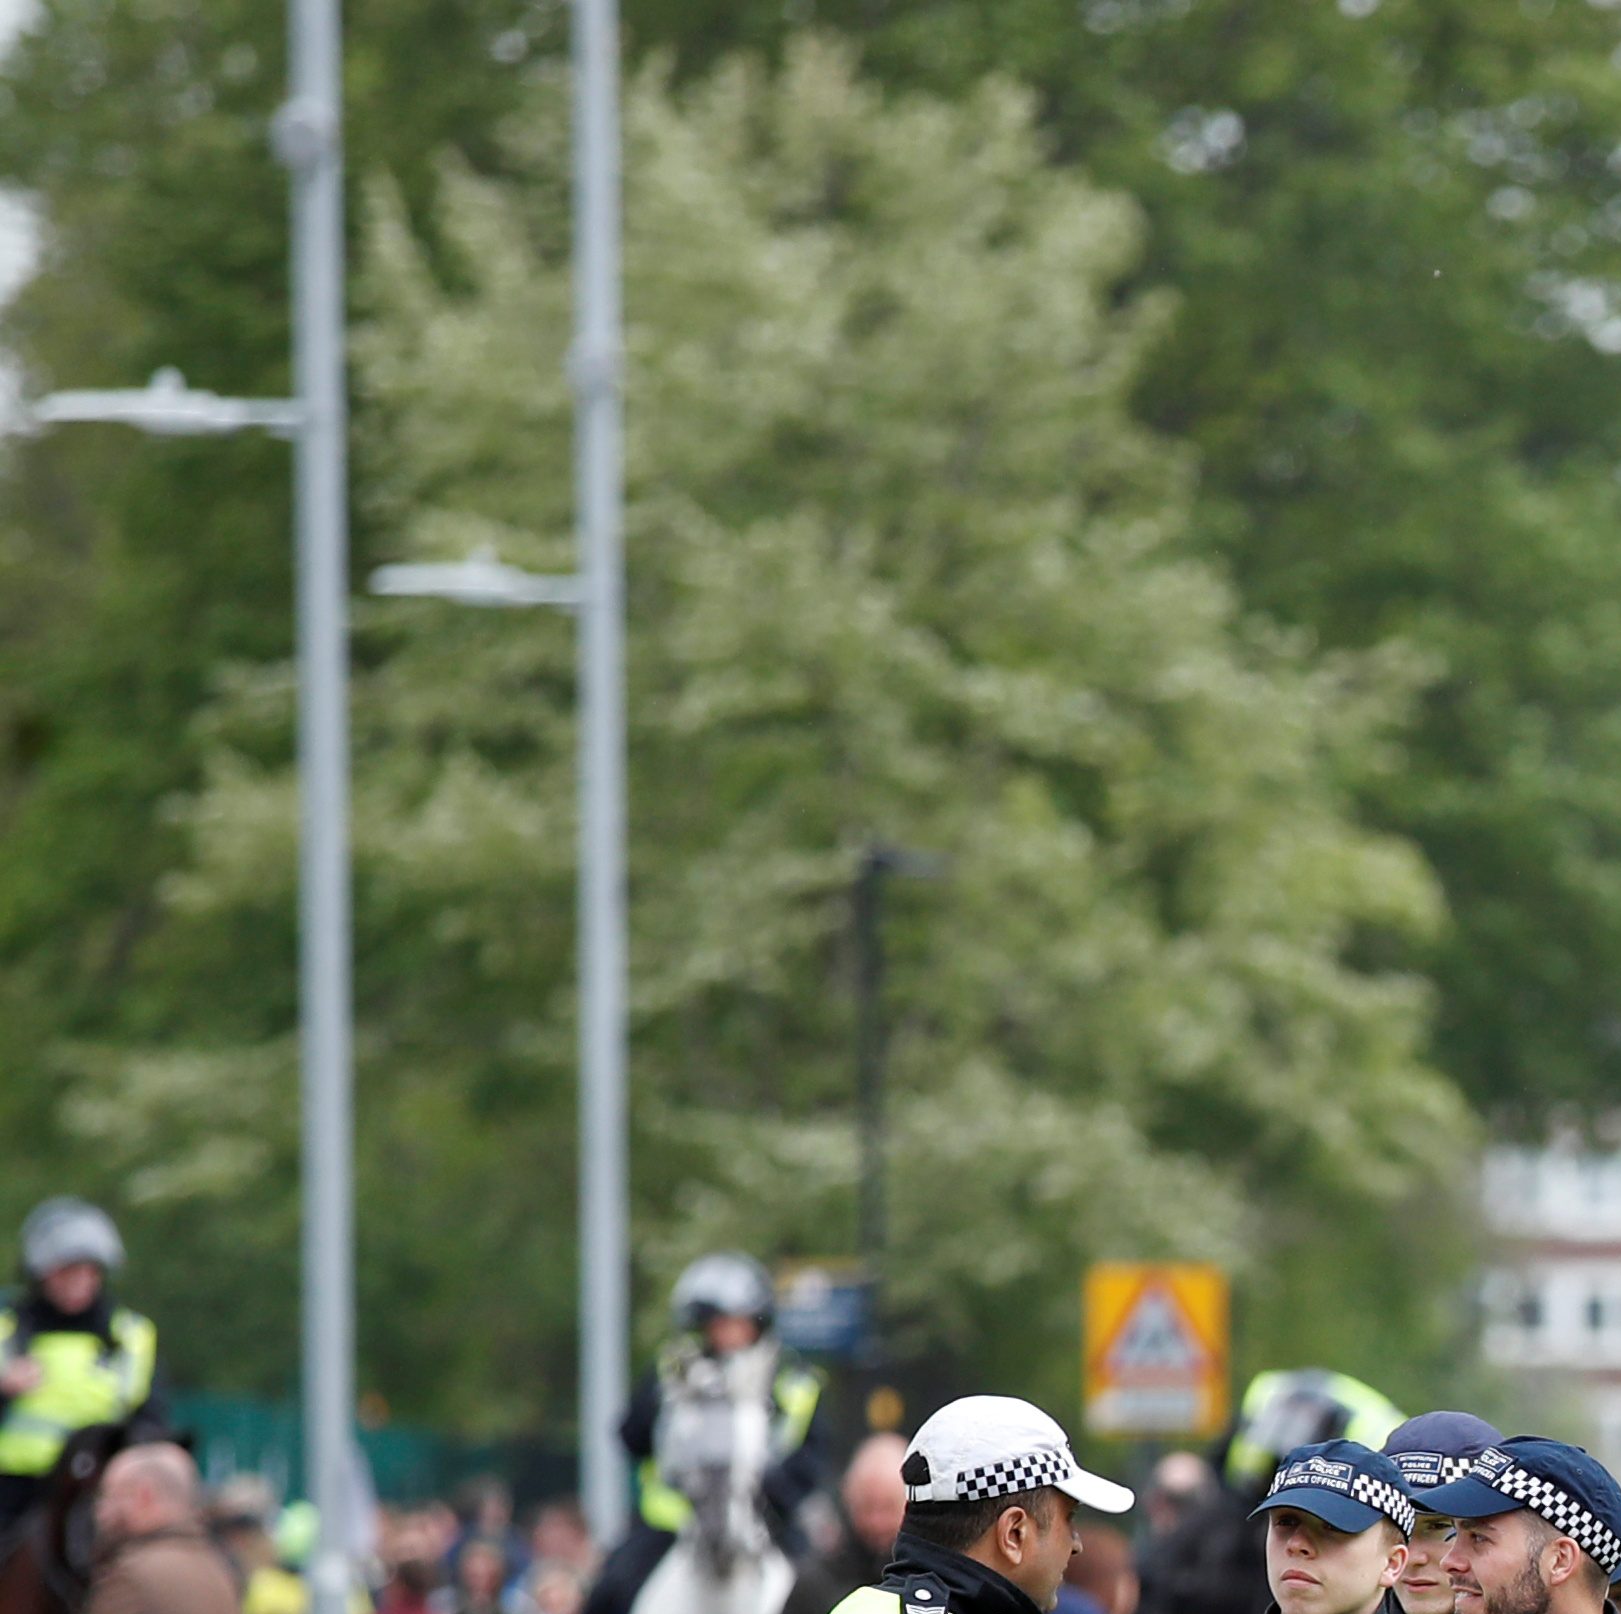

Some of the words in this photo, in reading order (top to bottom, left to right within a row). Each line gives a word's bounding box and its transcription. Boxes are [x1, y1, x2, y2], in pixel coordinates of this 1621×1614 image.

[1310, 1463, 1340, 1476] POLICE
[1401, 1461, 1431, 1469] POLICE
[1284, 1475, 1310, 1487] POLICE
[1310, 1475, 1349, 1490] OFFICER
[1403, 1472, 1439, 1484] OFFICER
